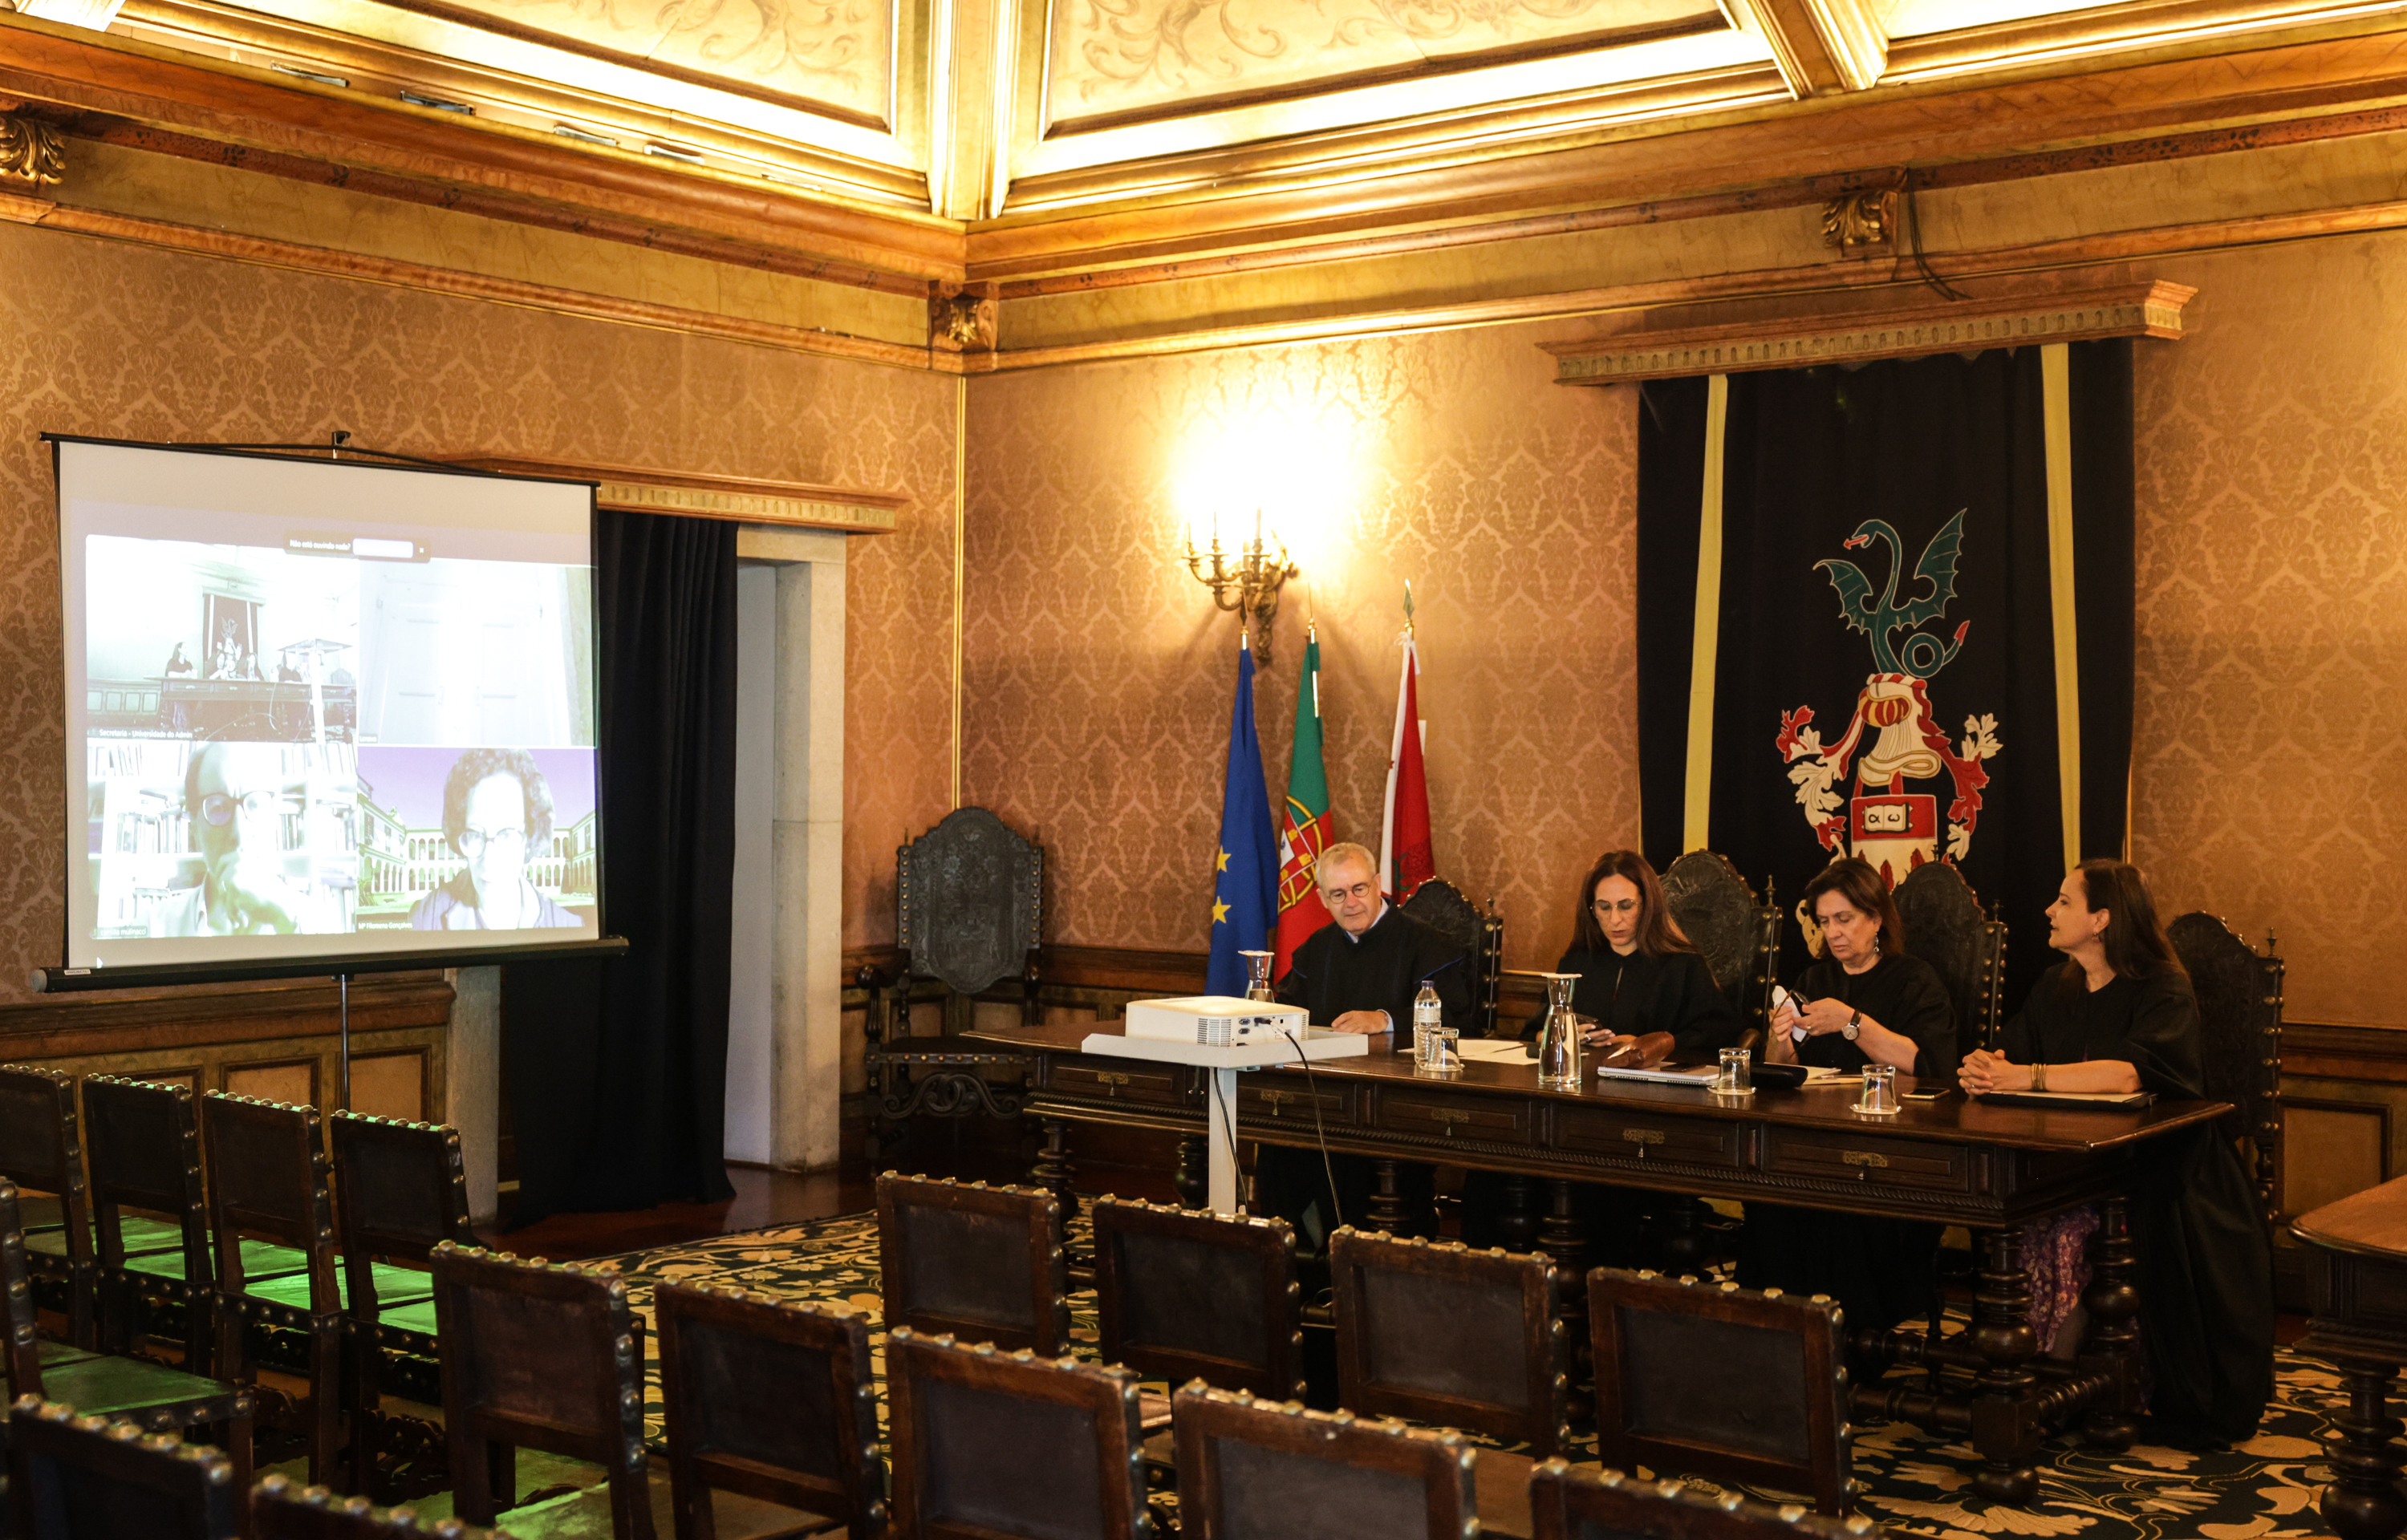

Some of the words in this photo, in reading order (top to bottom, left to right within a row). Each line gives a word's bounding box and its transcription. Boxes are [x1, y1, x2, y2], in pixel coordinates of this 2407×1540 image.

[290, 539, 302, 547] Não
[99, 728, 128, 737] Secretaria
[132, 729, 166, 738] Universidade
